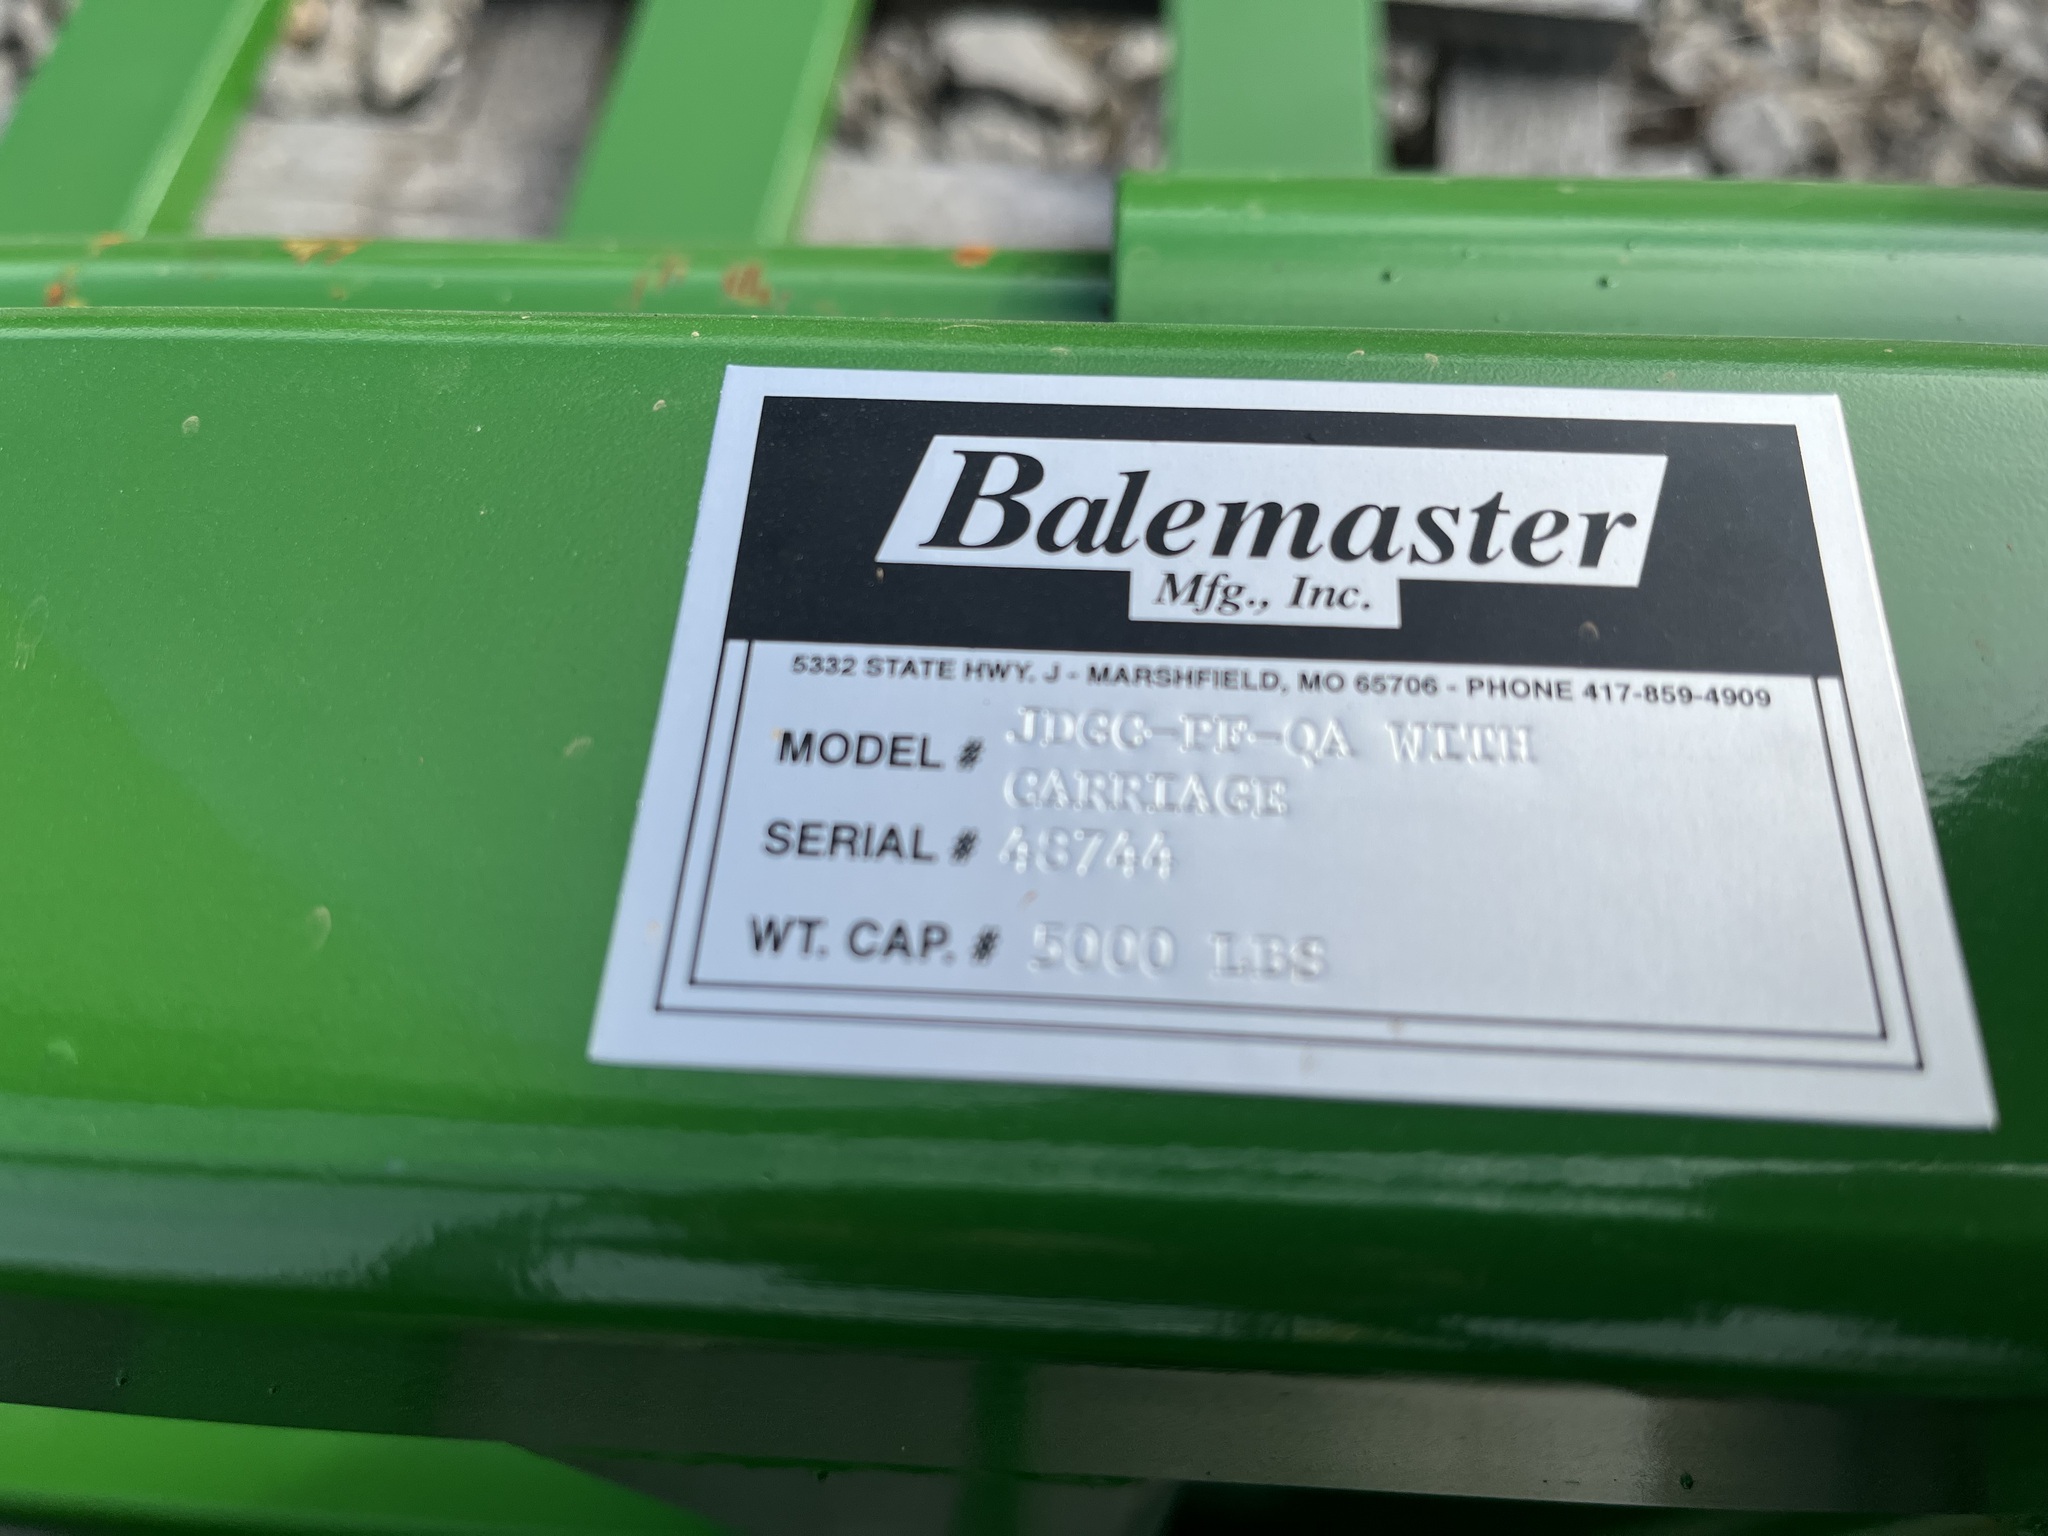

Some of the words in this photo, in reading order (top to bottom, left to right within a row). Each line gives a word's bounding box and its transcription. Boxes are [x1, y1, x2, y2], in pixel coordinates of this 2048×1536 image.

[919, 450, 1638, 569] Balemaster
[1156, 572, 1271, 616] Mfg.,
[1291, 575, 1372, 610] Inc.
[793, 655, 857, 676] 5332
[866, 657, 954, 680] STATE
[964, 661, 1037, 684] HWY.
[1044, 664, 1062, 683] J
[1087, 665, 1290, 694] MARSHFIELD,
[1300, 672, 1345, 693] MO
[1353, 674, 1438, 696] 65706
[1466, 679, 1573, 701] PHONE
[1582, 684, 1772, 707] 417-859-4909
[779, 730, 943, 769] MODEL
[957, 737, 985, 772] #
[1384, 719, 1535, 764] WITH
[1003, 768, 1290, 817] CARRIAGE
[764, 820, 935, 861] SERIAL
[952, 827, 978, 863] #
[750, 917, 830, 957] WT.
[850, 919, 957, 964] CAP.
[970, 925, 1000, 966] #
[1028, 921, 1178, 978] 5000
[1210, 930, 1327, 982] LBS
